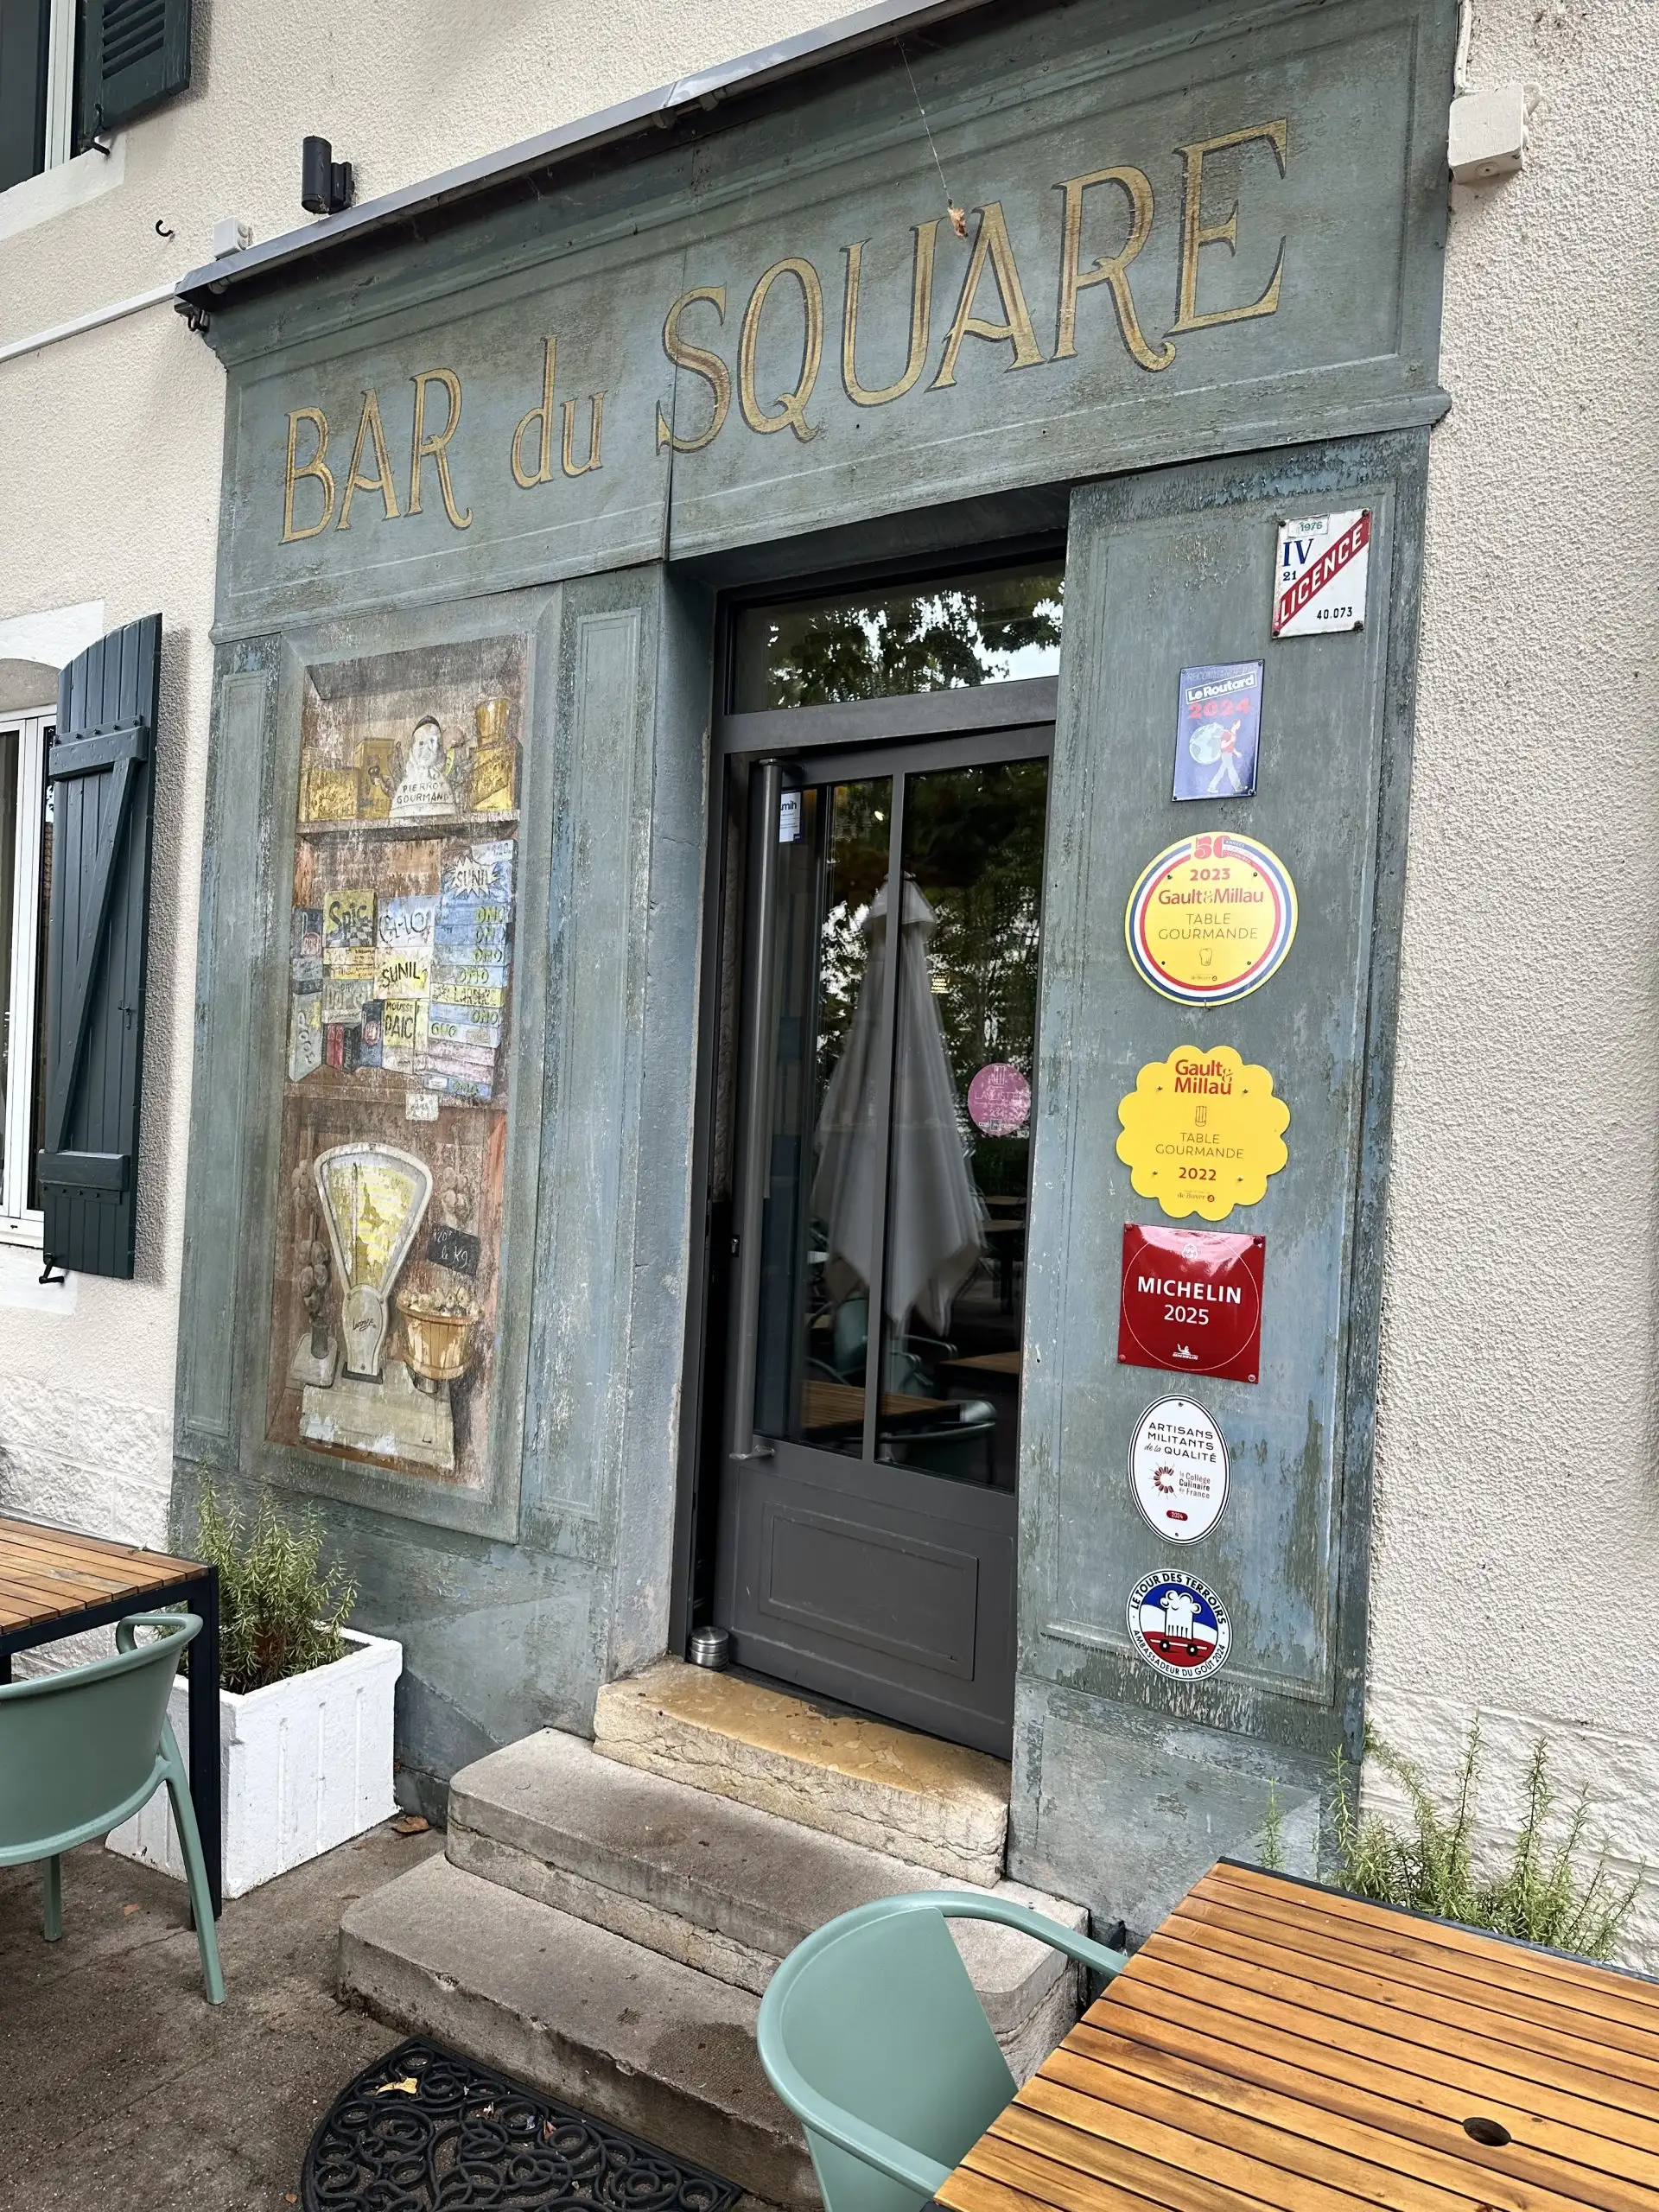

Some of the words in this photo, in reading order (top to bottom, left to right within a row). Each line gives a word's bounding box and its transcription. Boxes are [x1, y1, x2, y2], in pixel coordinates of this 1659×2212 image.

[278, 367, 473, 546] BAR
[511, 335, 608, 490] du
[656, 118, 1287, 455] SQUARE
[1300, 522, 1323, 532] 1976
[1282, 538, 1314, 567] IV
[1281, 523, 1363, 625] LICENCE
[1282, 570, 1297, 582] 21
[1317, 606, 1353, 620] 40.073
[1189, 697, 1250, 719] 2024
[1194, 836, 1231, 859] 50
[1190, 868, 1230, 881] 2023
[1186, 912, 1231, 925] TABLE
[1159, 928, 1258, 940] GOURMANDE
[382, 961, 420, 988] SUNIL
[472, 1009, 499, 1025] OMO
[385, 1014, 413, 1039] PAIC
[1174, 1077, 1232, 1095] Millau
[1179, 1133, 1220, 1144] TABLE
[1155, 1144, 1244, 1160] GOURMANDE
[1179, 1166, 1217, 1181] 2022
[1138, 1276, 1241, 1304] MICHELIN
[1164, 1305, 1209, 1325] 2025
[1149, 1421, 1213, 1440] ARTISANS
[1147, 1432, 1214, 1451] MILITANTS
[1154, 1444, 1161, 1452] la
[1164, 1446, 1217, 1463] QUALITÉ
[1179, 1479, 1211, 1491] Culinaire
[1186, 1488, 1211, 1499] France
[1135, 1575, 1160, 1598] TOUR
[1162, 1573, 1182, 1583] DES
[1131, 1597, 1141, 1610] LE
[1185, 1577, 1227, 1624] TERROIRS
[1133, 1630, 1179, 1675] AMBASSADEUR
[1194, 1662, 1214, 1675] GOÛT
[1213, 1643, 1226, 1662] 2024
